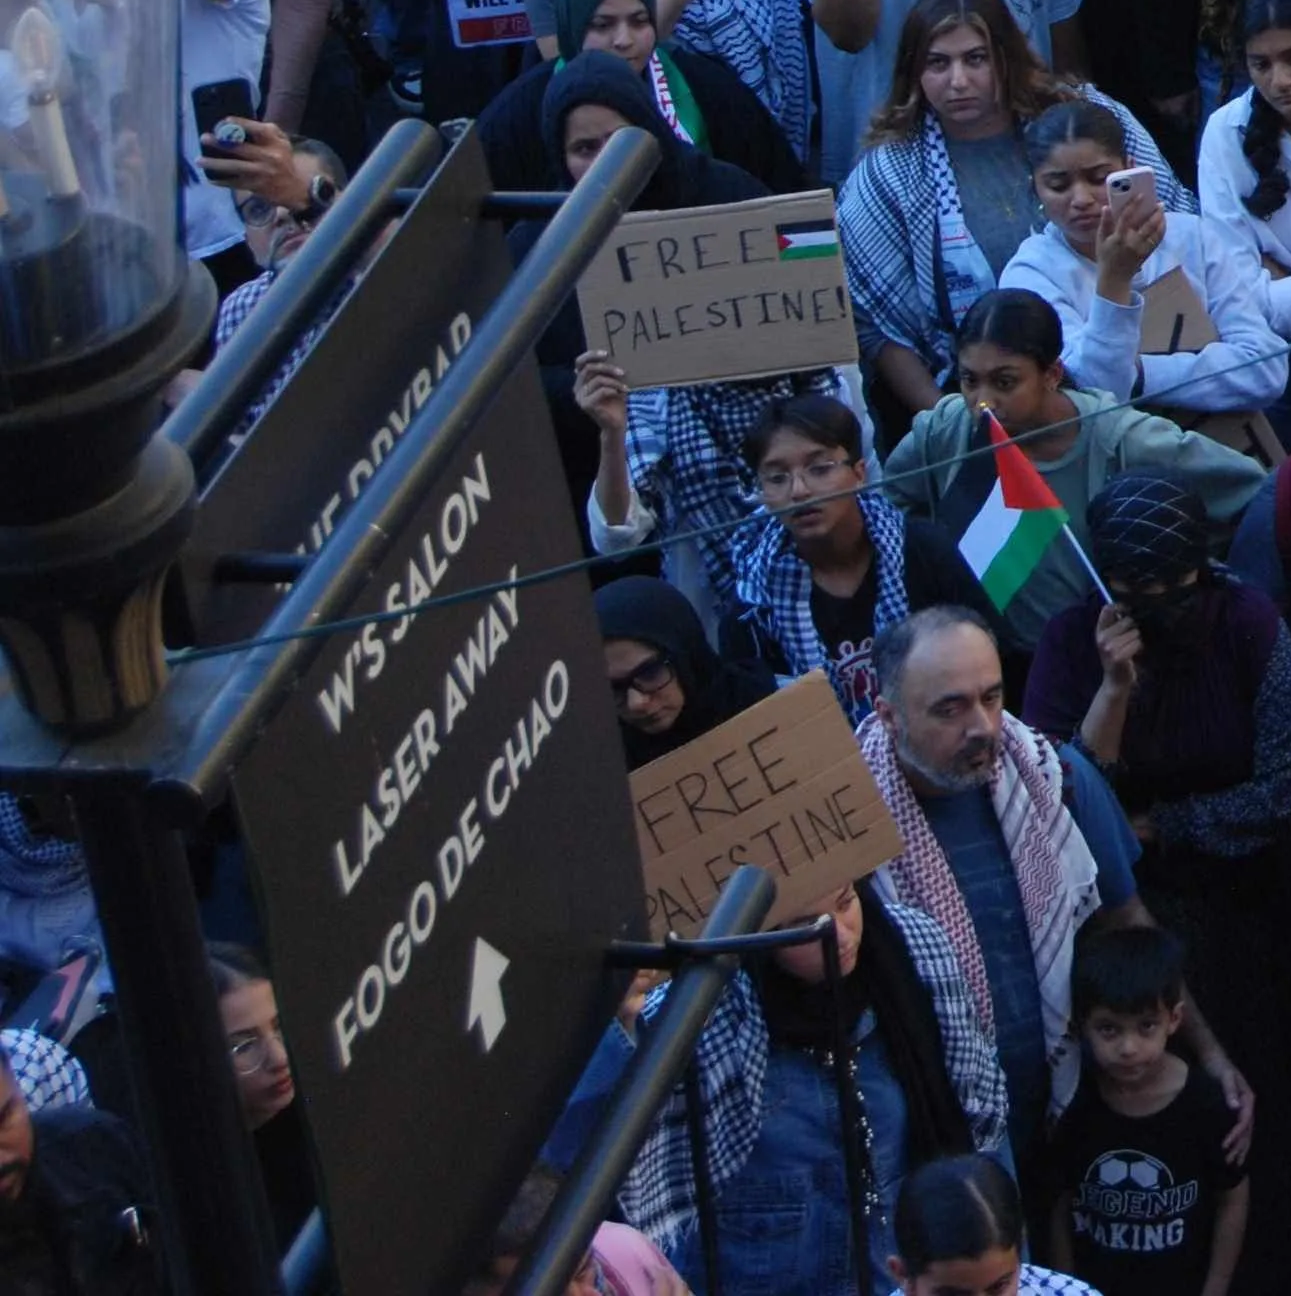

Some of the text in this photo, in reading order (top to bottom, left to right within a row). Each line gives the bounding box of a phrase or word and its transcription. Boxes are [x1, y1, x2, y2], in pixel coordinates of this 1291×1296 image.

[604, 285, 847, 357] PALESTINE!
[616, 227, 776, 283] FREE
[319, 452, 491, 735] W'S SALON
[335, 563, 522, 896] LASER AWAY
[637, 726, 797, 855] FREE
[334, 659, 569, 1069] FOGO DE CHAO
